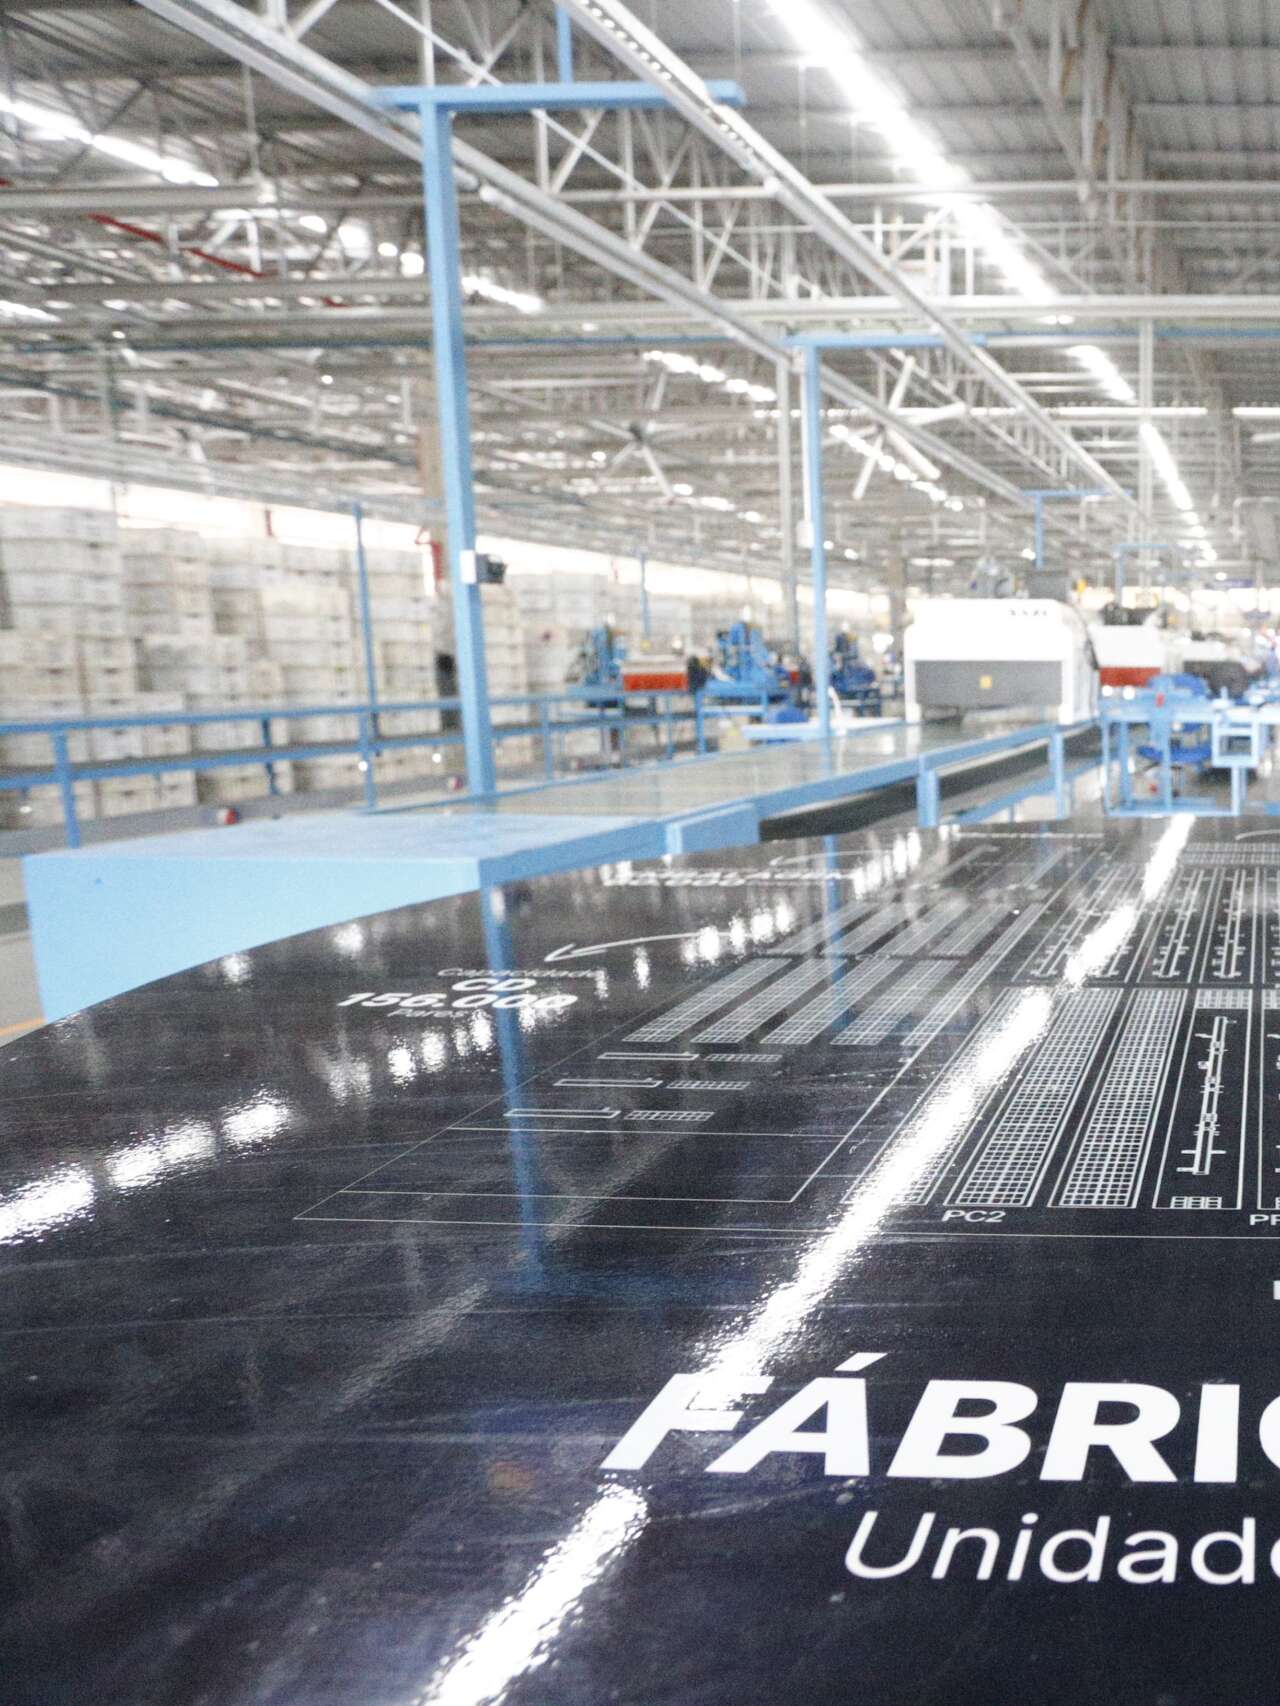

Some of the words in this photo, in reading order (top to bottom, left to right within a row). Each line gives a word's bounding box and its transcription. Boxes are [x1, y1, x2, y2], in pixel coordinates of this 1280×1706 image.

[452, 978, 537, 991] CD
[336, 992, 578, 1008] 156.000
[387, 1008, 468, 1017] Pares
[942, 1209, 1007, 1224] PC2
